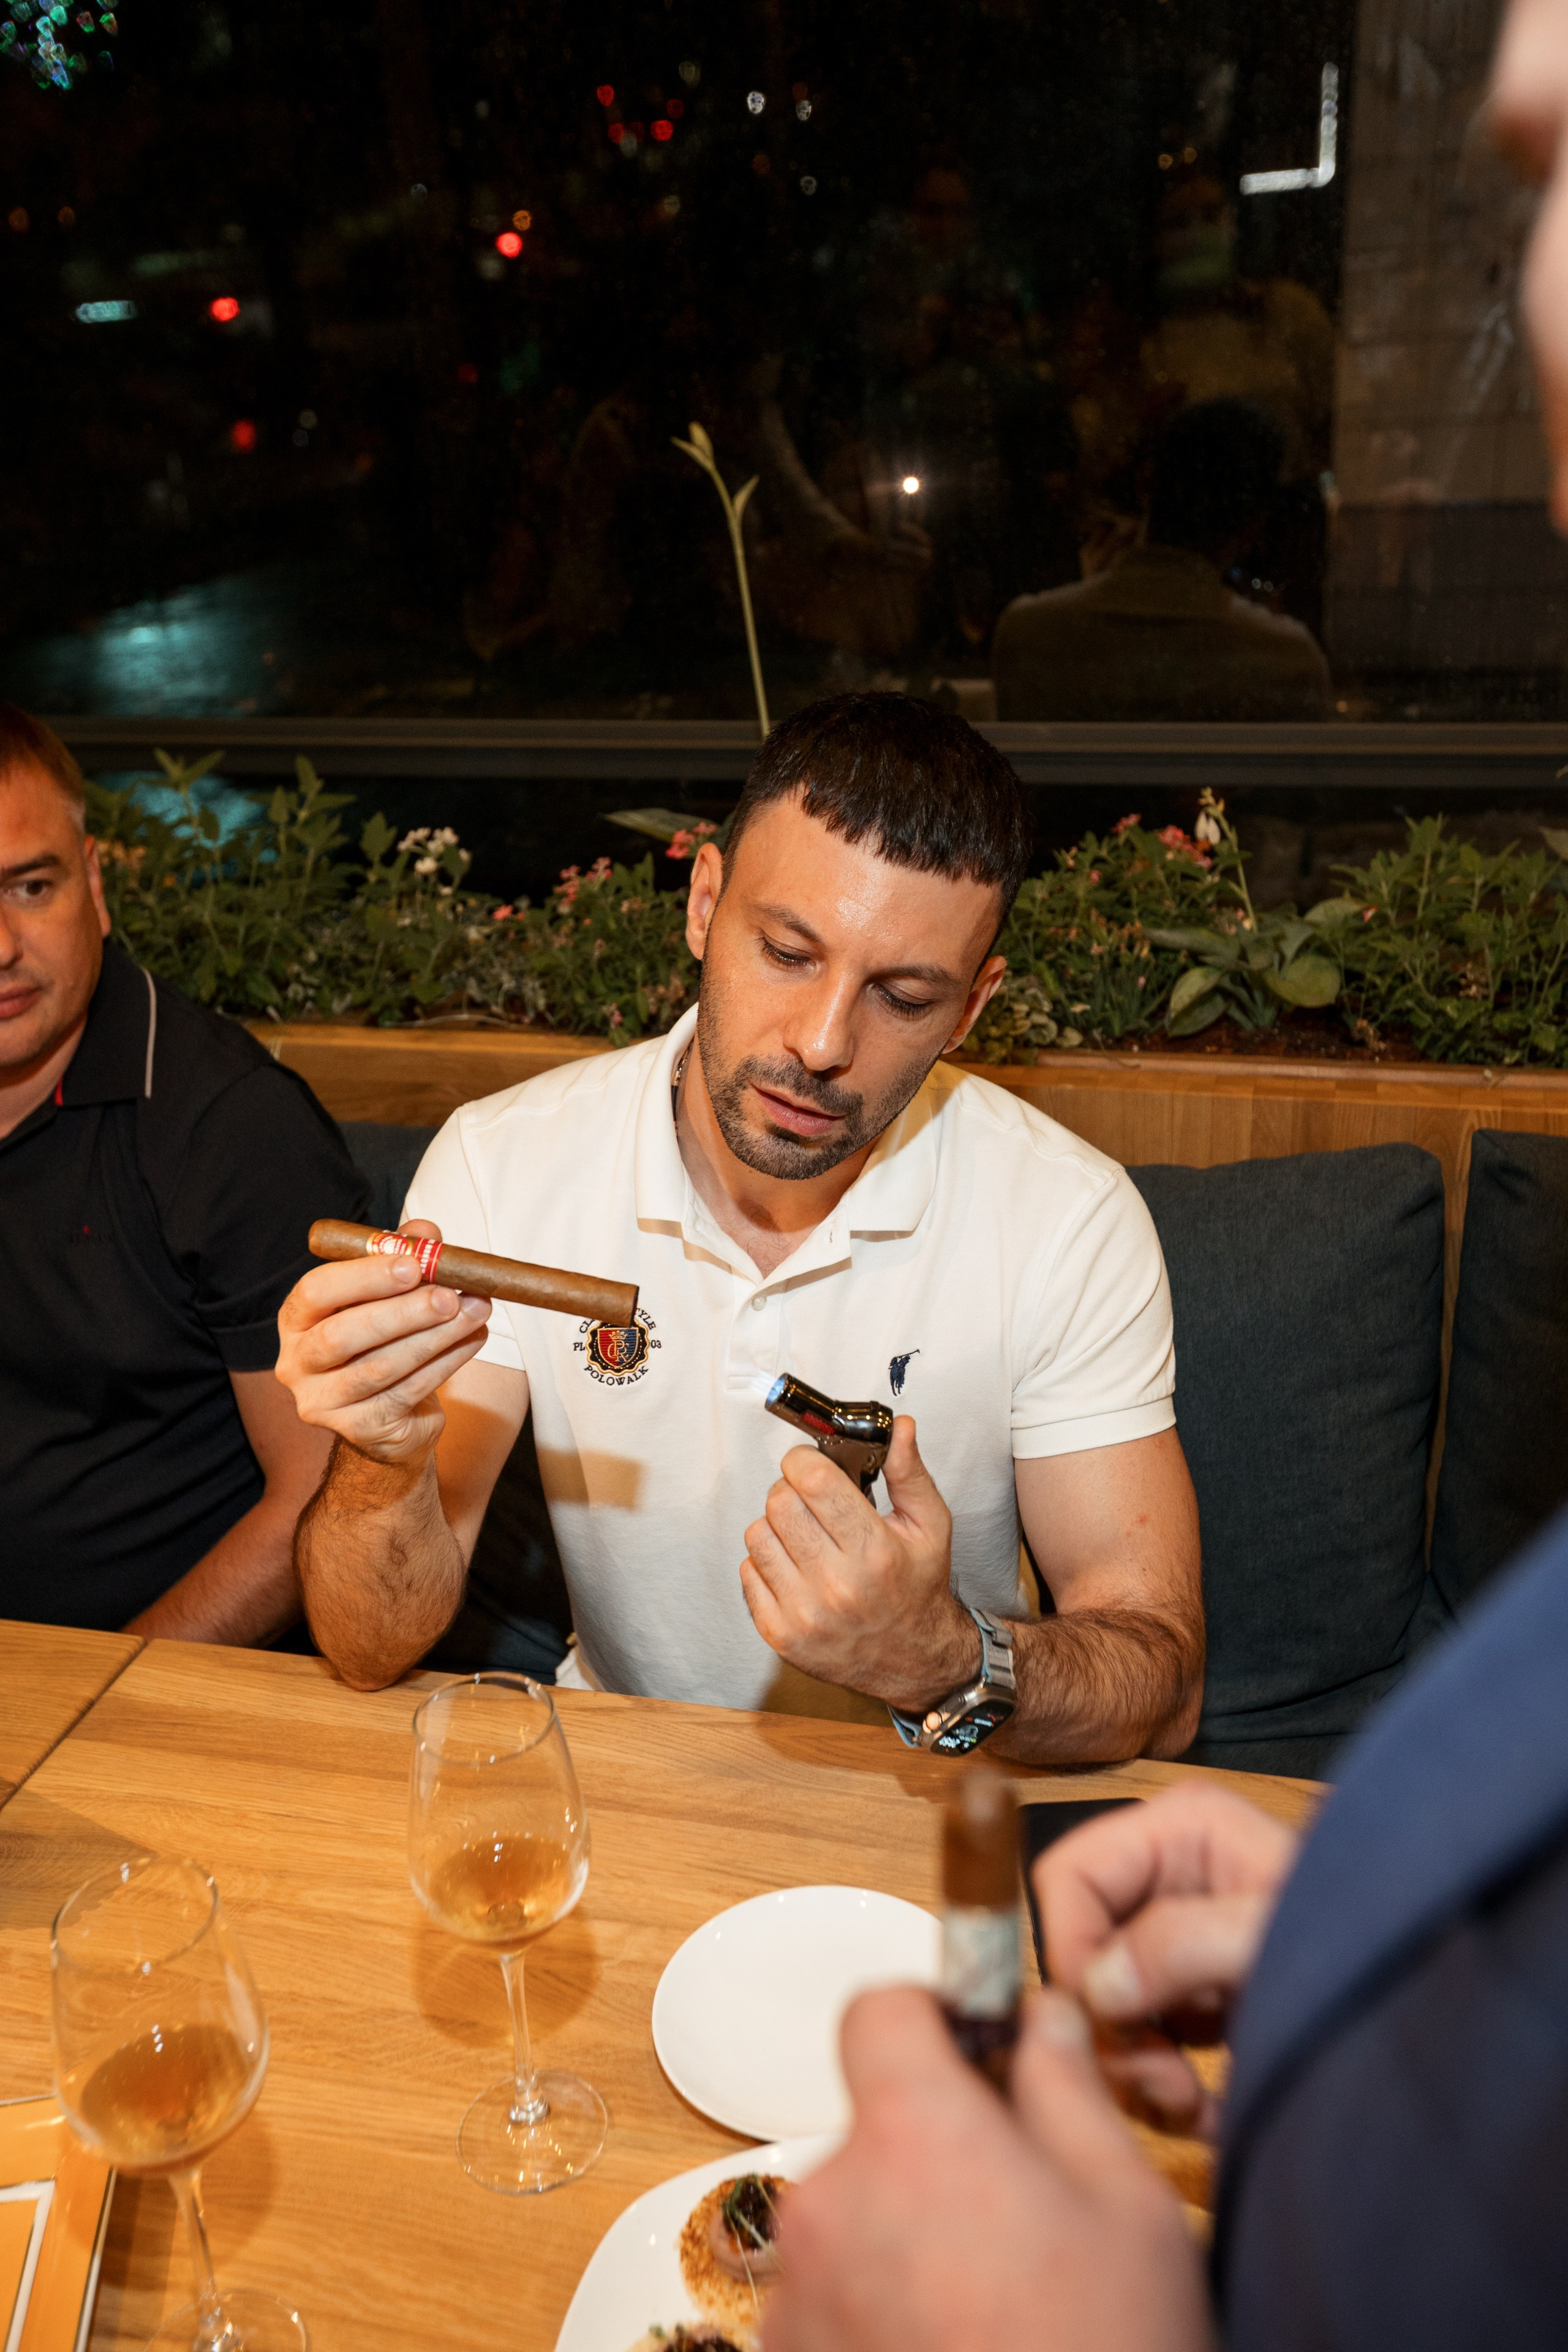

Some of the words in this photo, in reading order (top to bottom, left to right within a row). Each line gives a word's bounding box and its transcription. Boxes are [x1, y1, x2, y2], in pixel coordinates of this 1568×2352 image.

[573, 1342, 586, 1351] PL
[650, 1340, 662, 1349] 03
[584, 1363, 649, 1385] POLOWALK
